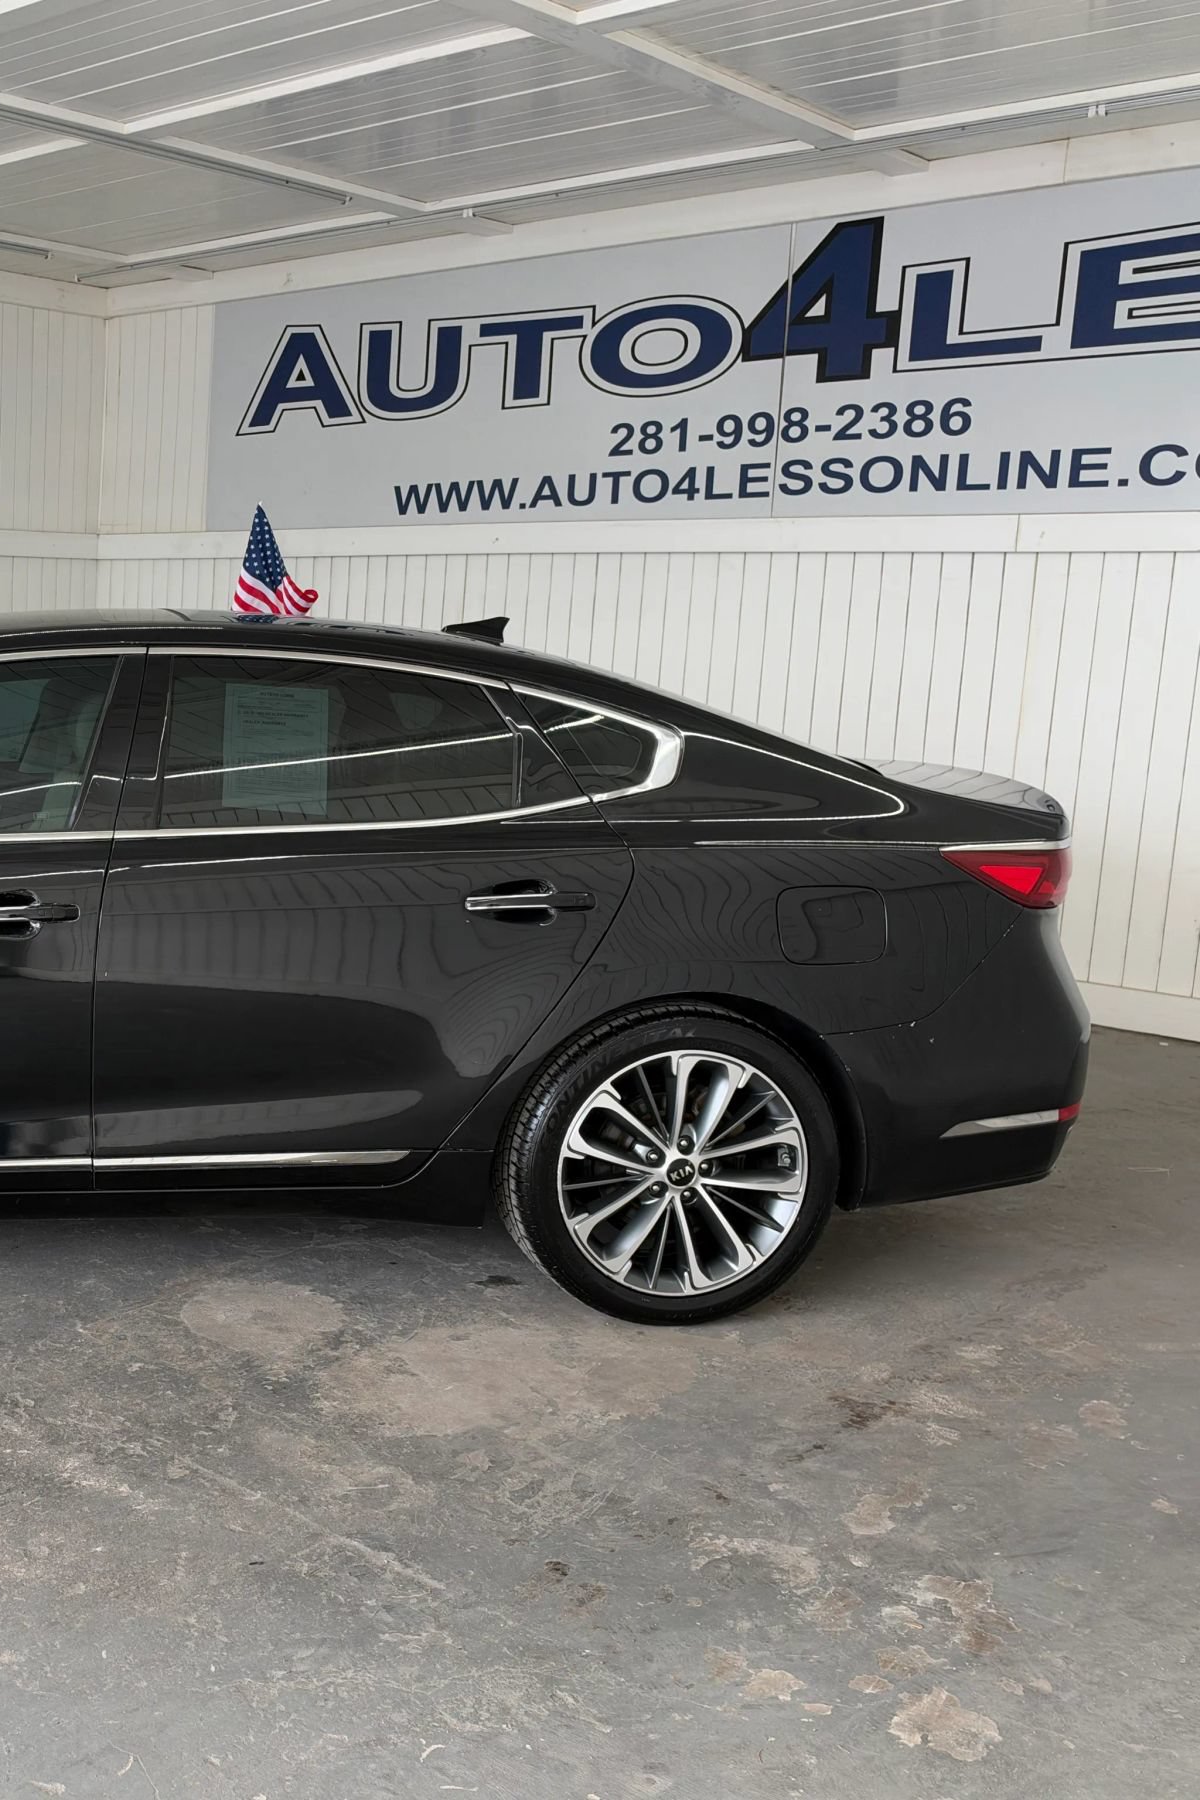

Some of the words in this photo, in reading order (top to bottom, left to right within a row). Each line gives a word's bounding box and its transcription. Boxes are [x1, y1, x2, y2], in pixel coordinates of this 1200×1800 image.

[608, 398, 973, 457] 281-998-2386
[394, 444, 1200, 515] WWW.AUTO4LESSONLINE.C
[670, 1165, 693, 1181] KIA
